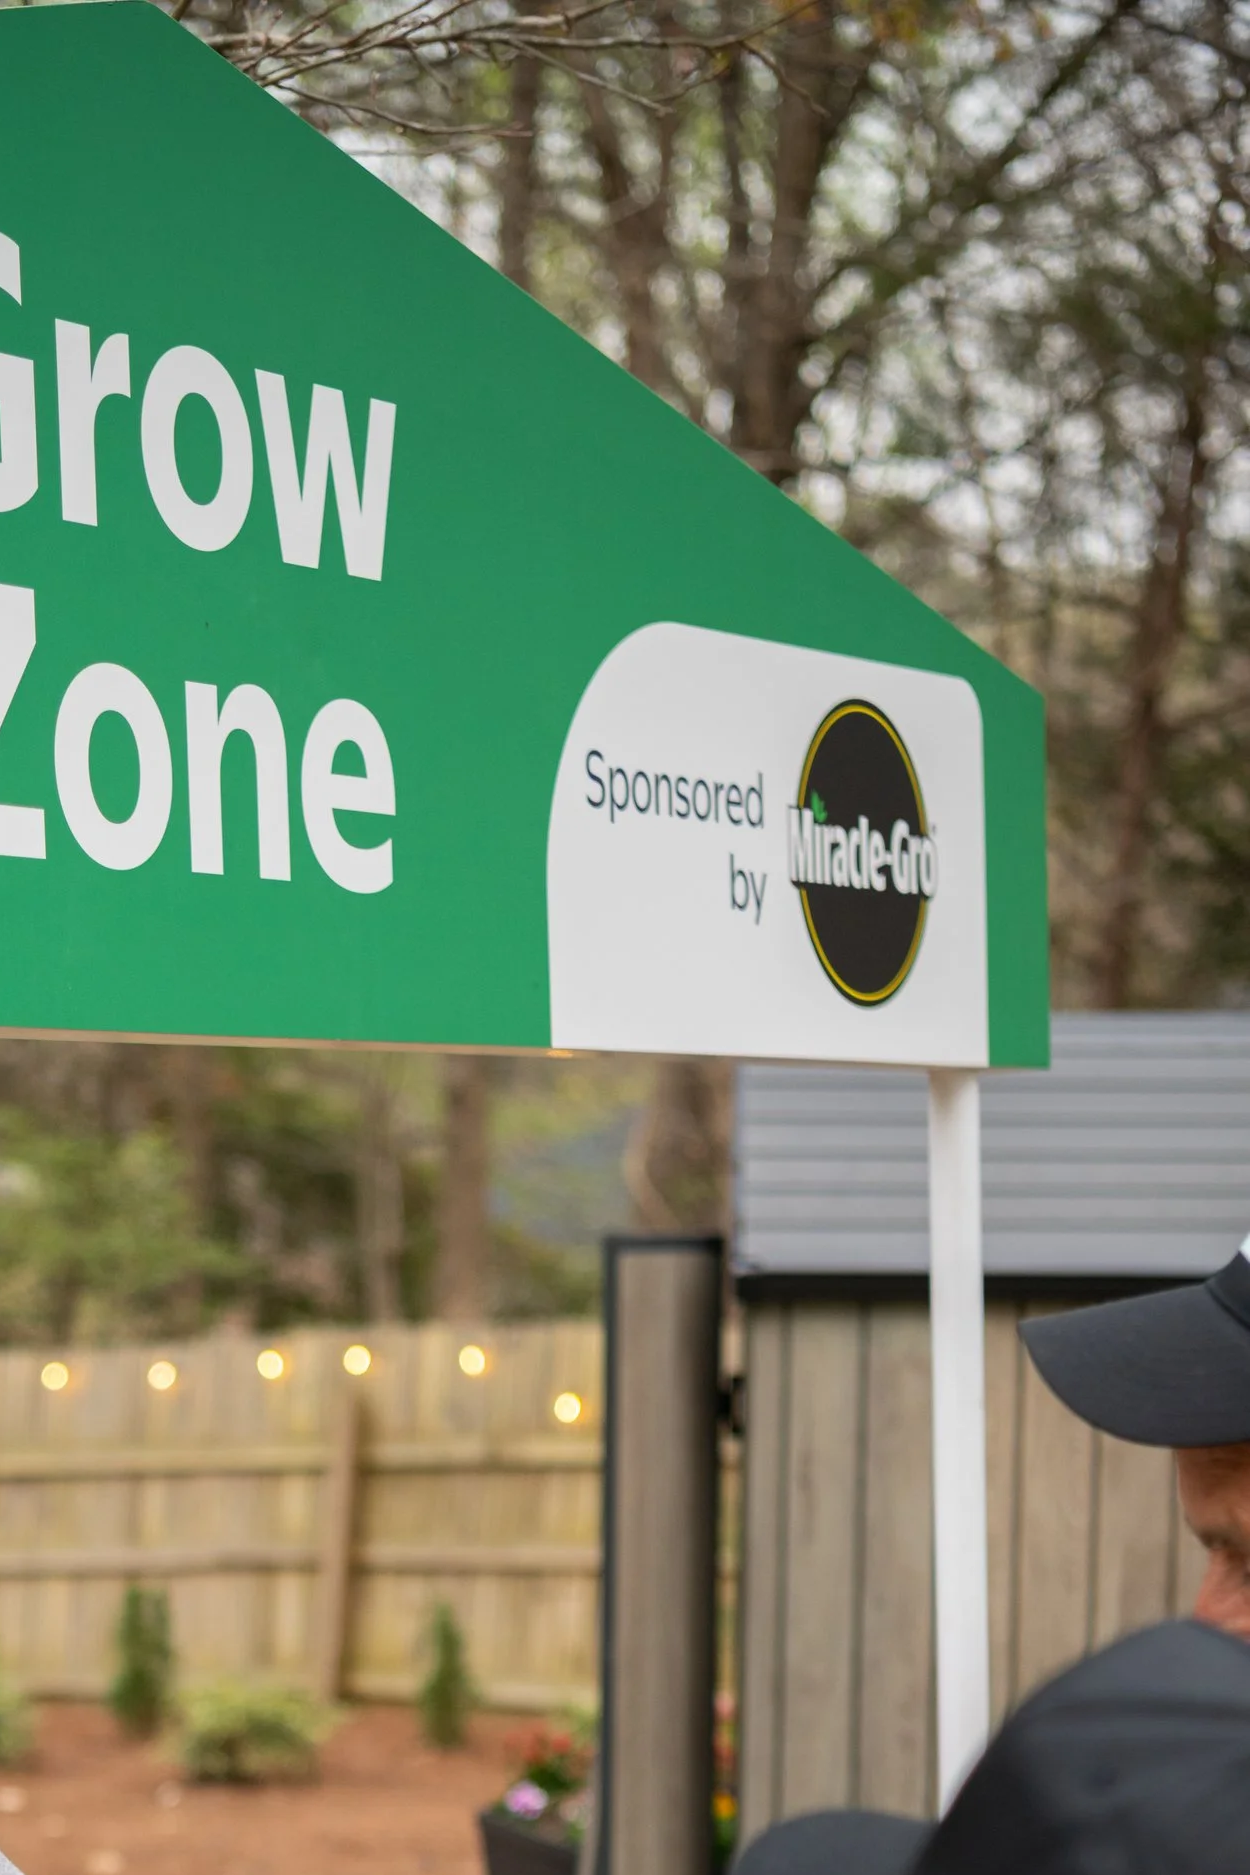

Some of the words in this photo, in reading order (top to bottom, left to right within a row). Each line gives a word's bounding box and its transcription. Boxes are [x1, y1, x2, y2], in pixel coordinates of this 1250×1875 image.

[585, 749, 764, 828] Sponsored
[729, 853, 767, 925] by
[787, 805, 937, 898] Miracle-Gro
